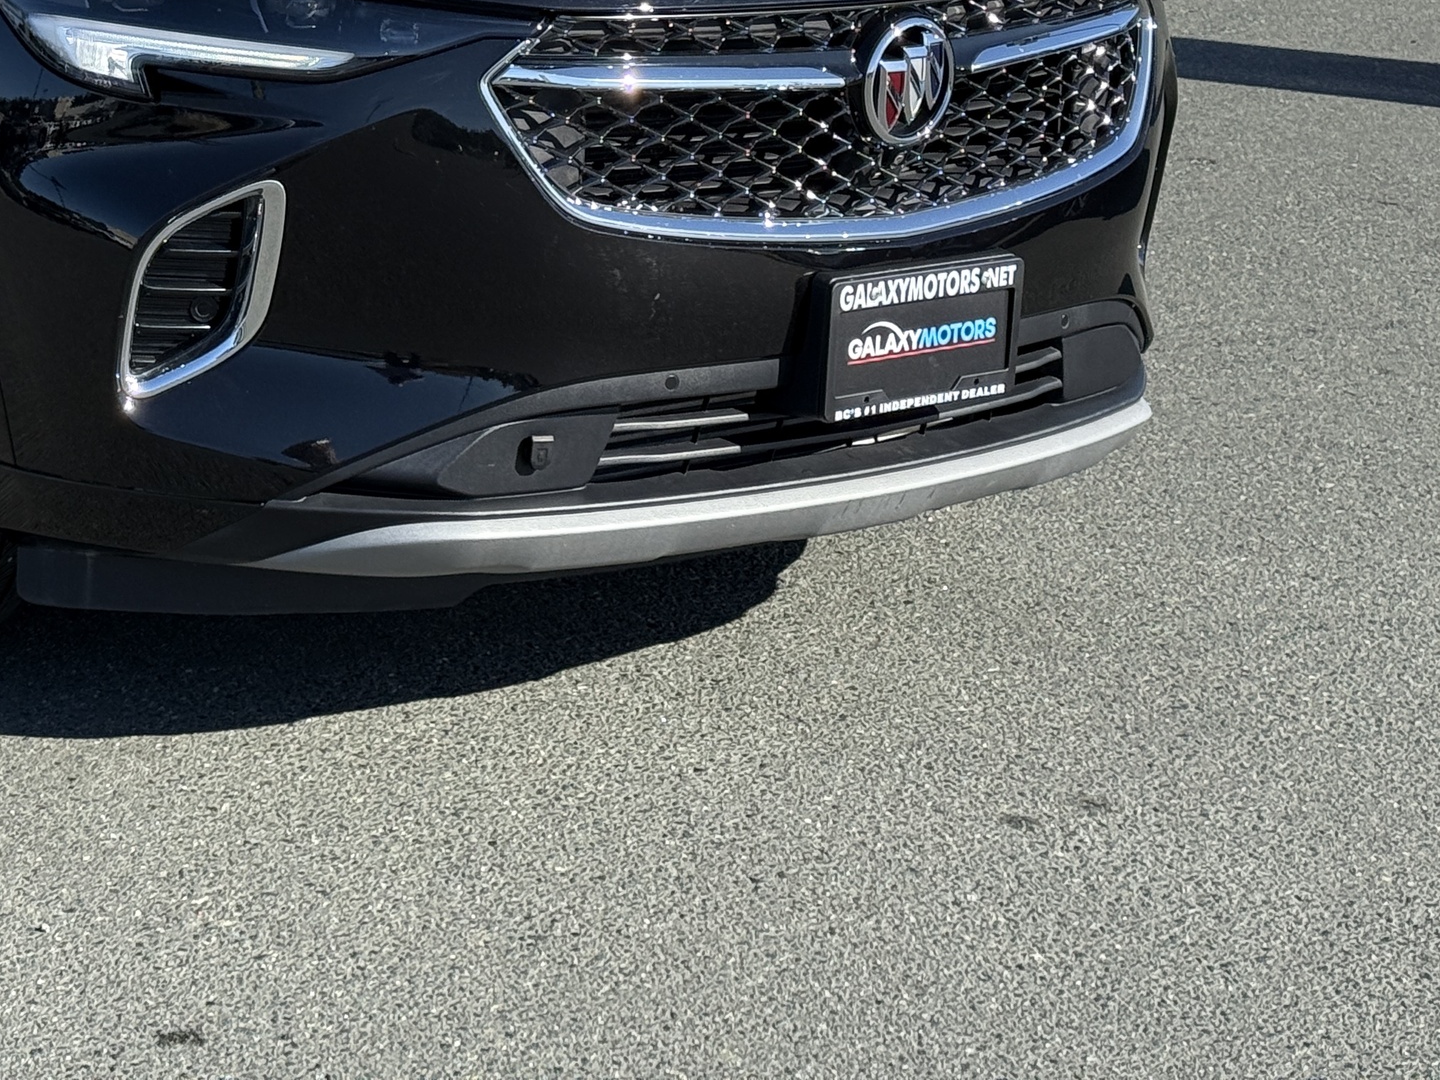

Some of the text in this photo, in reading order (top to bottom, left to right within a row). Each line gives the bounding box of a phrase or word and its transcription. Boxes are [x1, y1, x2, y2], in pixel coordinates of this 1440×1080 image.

[839, 264, 1017, 312] GALAXYMOTORSNET
[847, 317, 997, 360] GALAXYMOTORS
[879, 390, 960, 414] INDEPENDENT
[961, 383, 1006, 400] DEALER
